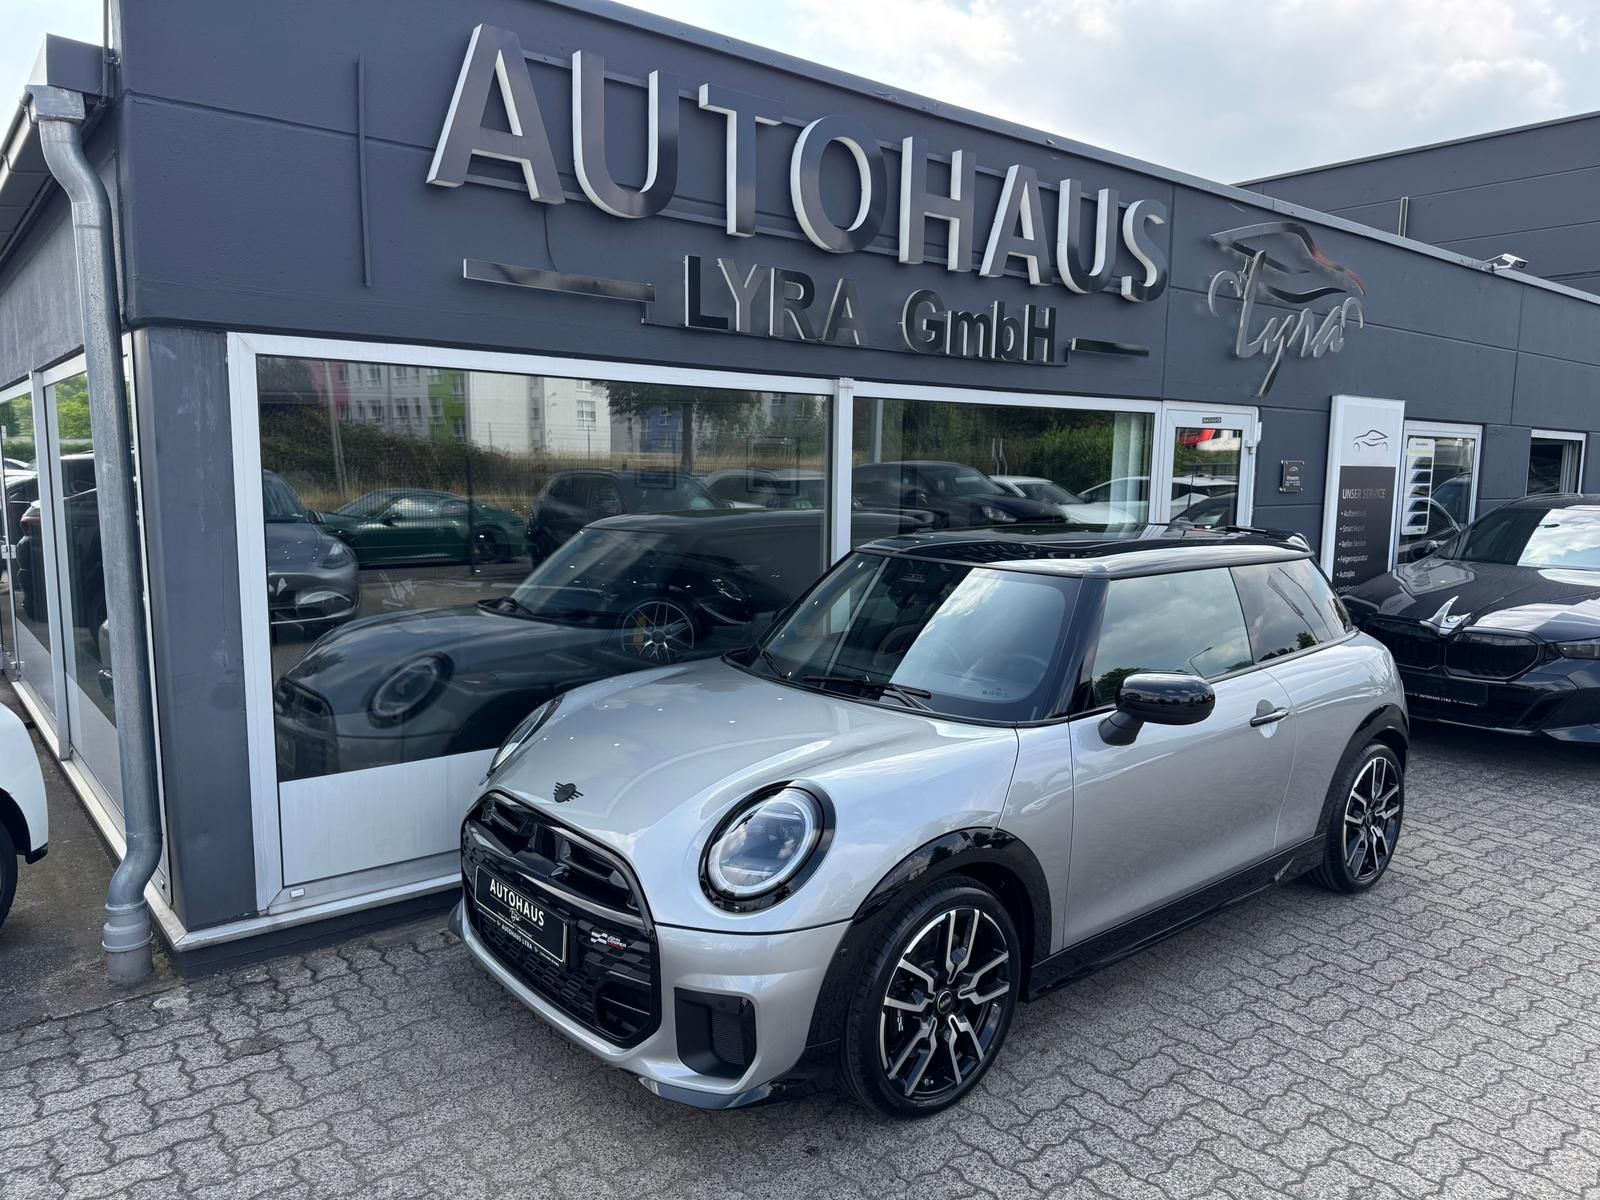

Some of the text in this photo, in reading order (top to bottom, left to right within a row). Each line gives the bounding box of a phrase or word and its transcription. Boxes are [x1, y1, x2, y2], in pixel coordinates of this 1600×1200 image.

[426, 23, 1168, 303] AUTOHAUS
[684, 255, 1057, 363] LYRA GmbH
[1342, 487, 1387, 500] UNSER SERVICE
[490, 878, 545, 926] AUTOHAUS
[501, 924, 522, 942] AUTOHAUS
[521, 938, 533, 950] LYRA
